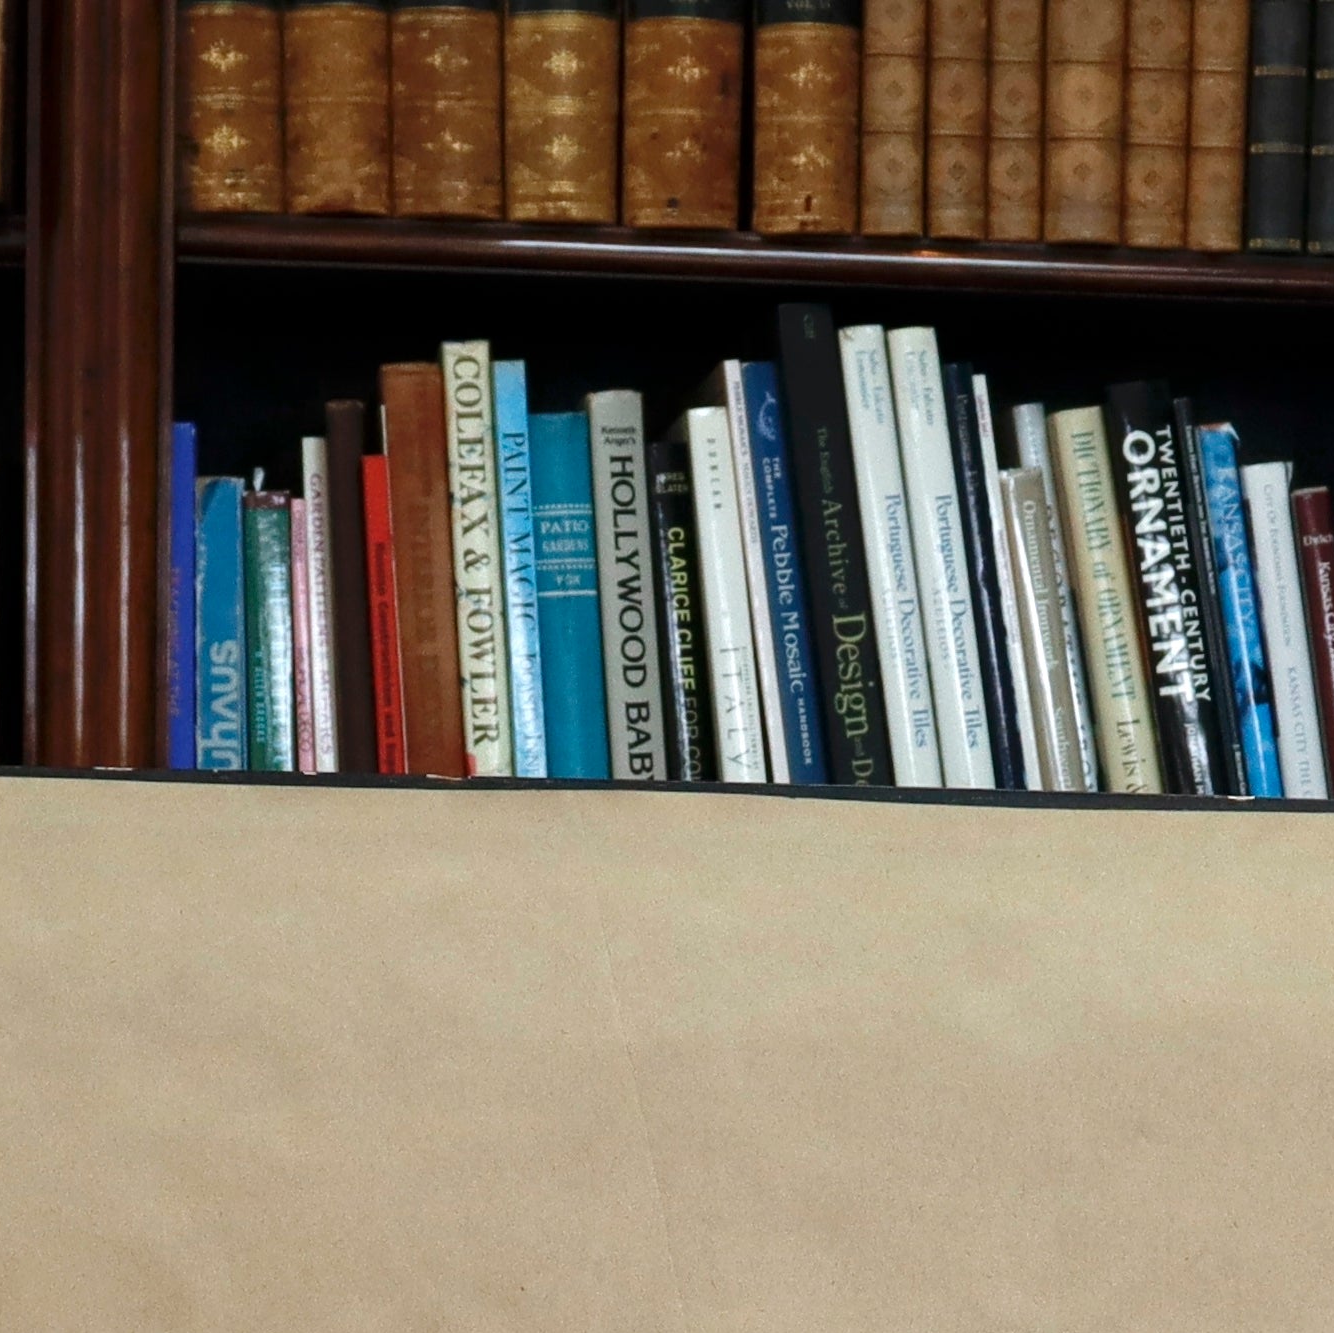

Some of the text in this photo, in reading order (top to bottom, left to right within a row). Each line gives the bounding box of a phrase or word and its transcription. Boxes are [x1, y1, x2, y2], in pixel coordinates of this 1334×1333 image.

[454, 356, 500, 746] COLEFAX & FOWLER
[502, 432, 536, 622] PAINT MAGIC
[541, 519, 591, 535] PATIO
[823, 498, 848, 593] Archive
[1071, 431, 1113, 551] DICTIONARY
[1302, 534, 1334, 547] Ehrlich
[609, 455, 648, 689] HOLLYWOOD
[763, 458, 814, 766] COMPLETE Pebble Mosaic HANDBOOK
[885, 493, 932, 749] Portuguese Decorative Tiles
[935, 495, 982, 750] Portuguese Decorative Tiles
[1023, 502, 1061, 669] Ornamental Ironwork
[1122, 430, 1192, 701] ORNAMENT
[1157, 425, 1211, 701] TWENTIETH CENTURY
[1236, 568, 1255, 623] CITY
[668, 527, 698, 739] CLARICE CLIFF FOR
[832, 613, 874, 739] Design
[1098, 588, 1135, 700] ORNAMENT
[1288, 667, 1304, 718] KANSAS
[720, 647, 752, 770] ITALY
[1116, 720, 1143, 778] Lewis
[1294, 722, 1308, 753] CITY
